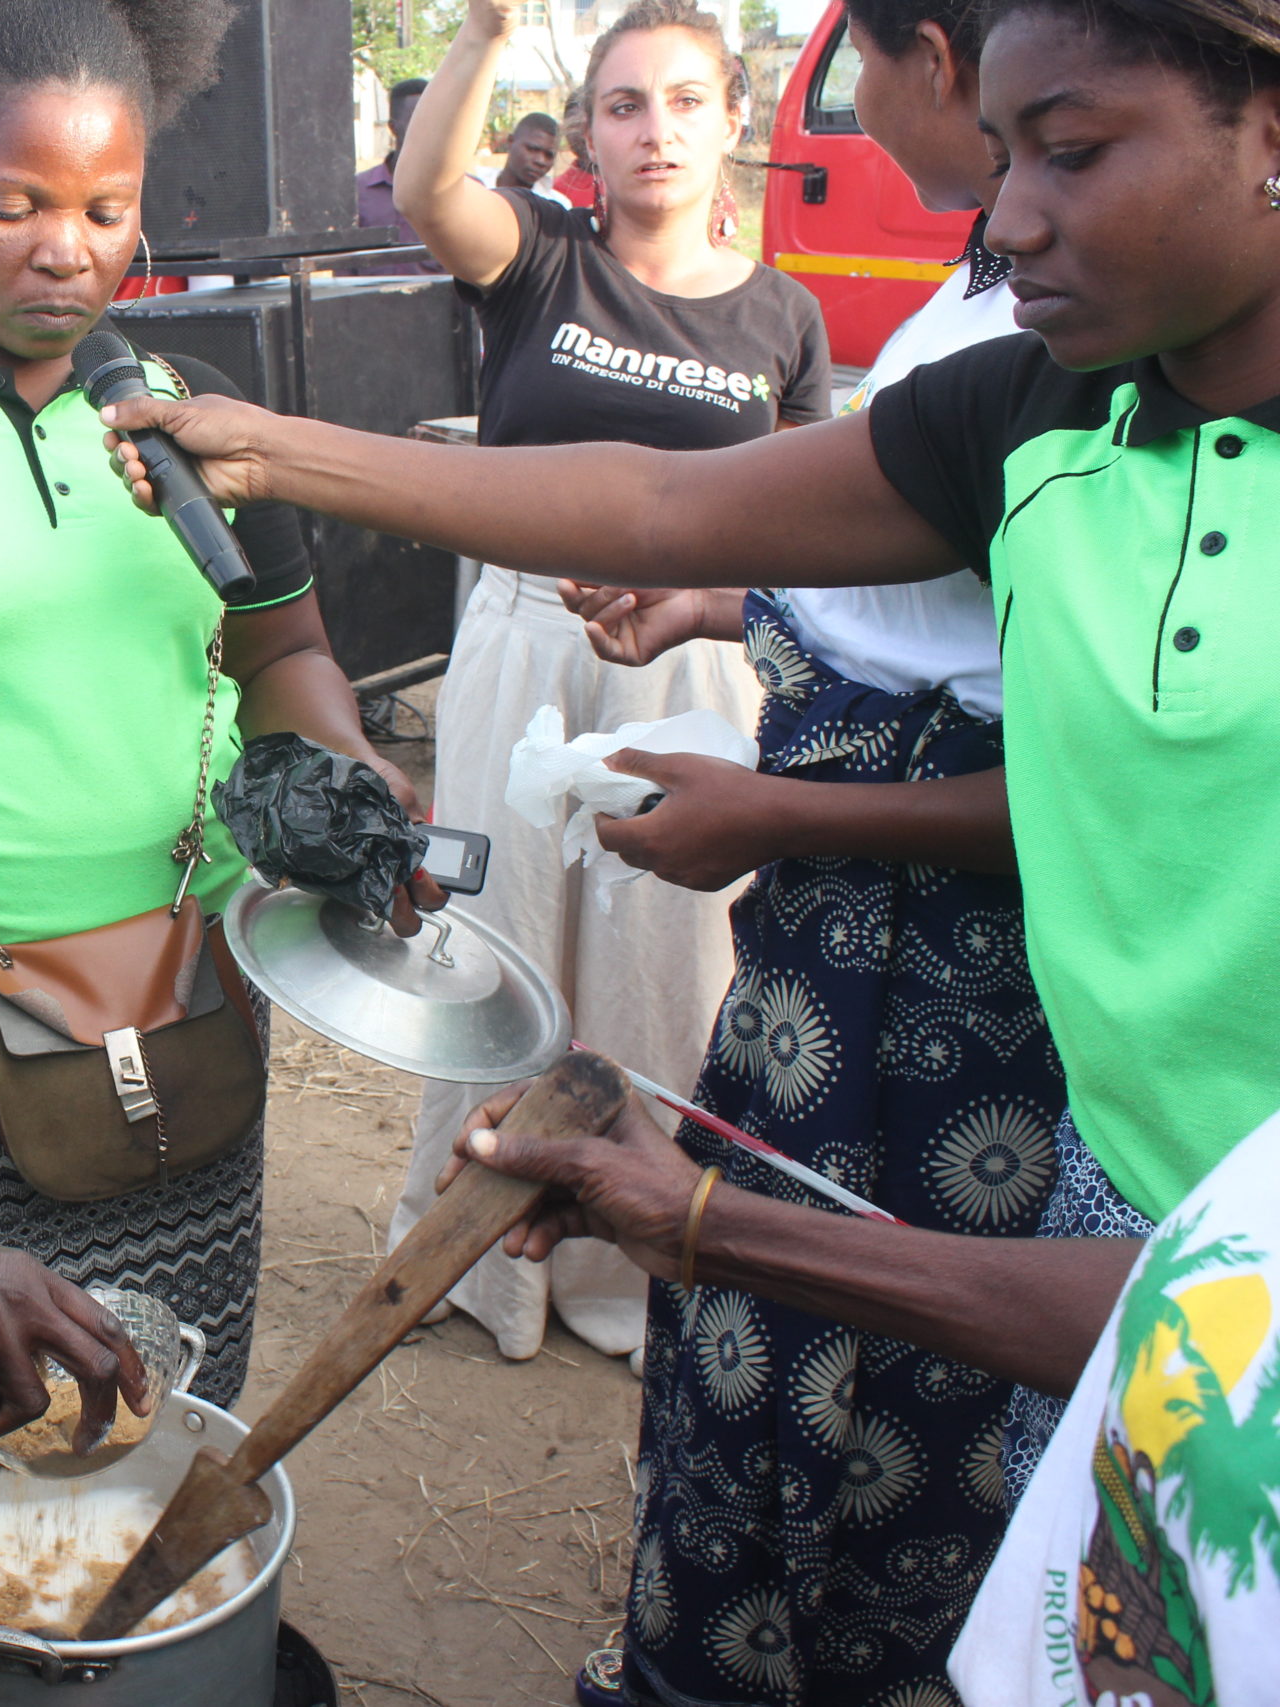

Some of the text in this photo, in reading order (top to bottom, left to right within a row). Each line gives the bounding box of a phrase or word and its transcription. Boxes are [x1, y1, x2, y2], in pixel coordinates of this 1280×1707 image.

[551, 353, 740, 413] UN IMPEGNO DI GIUSTIZIA
